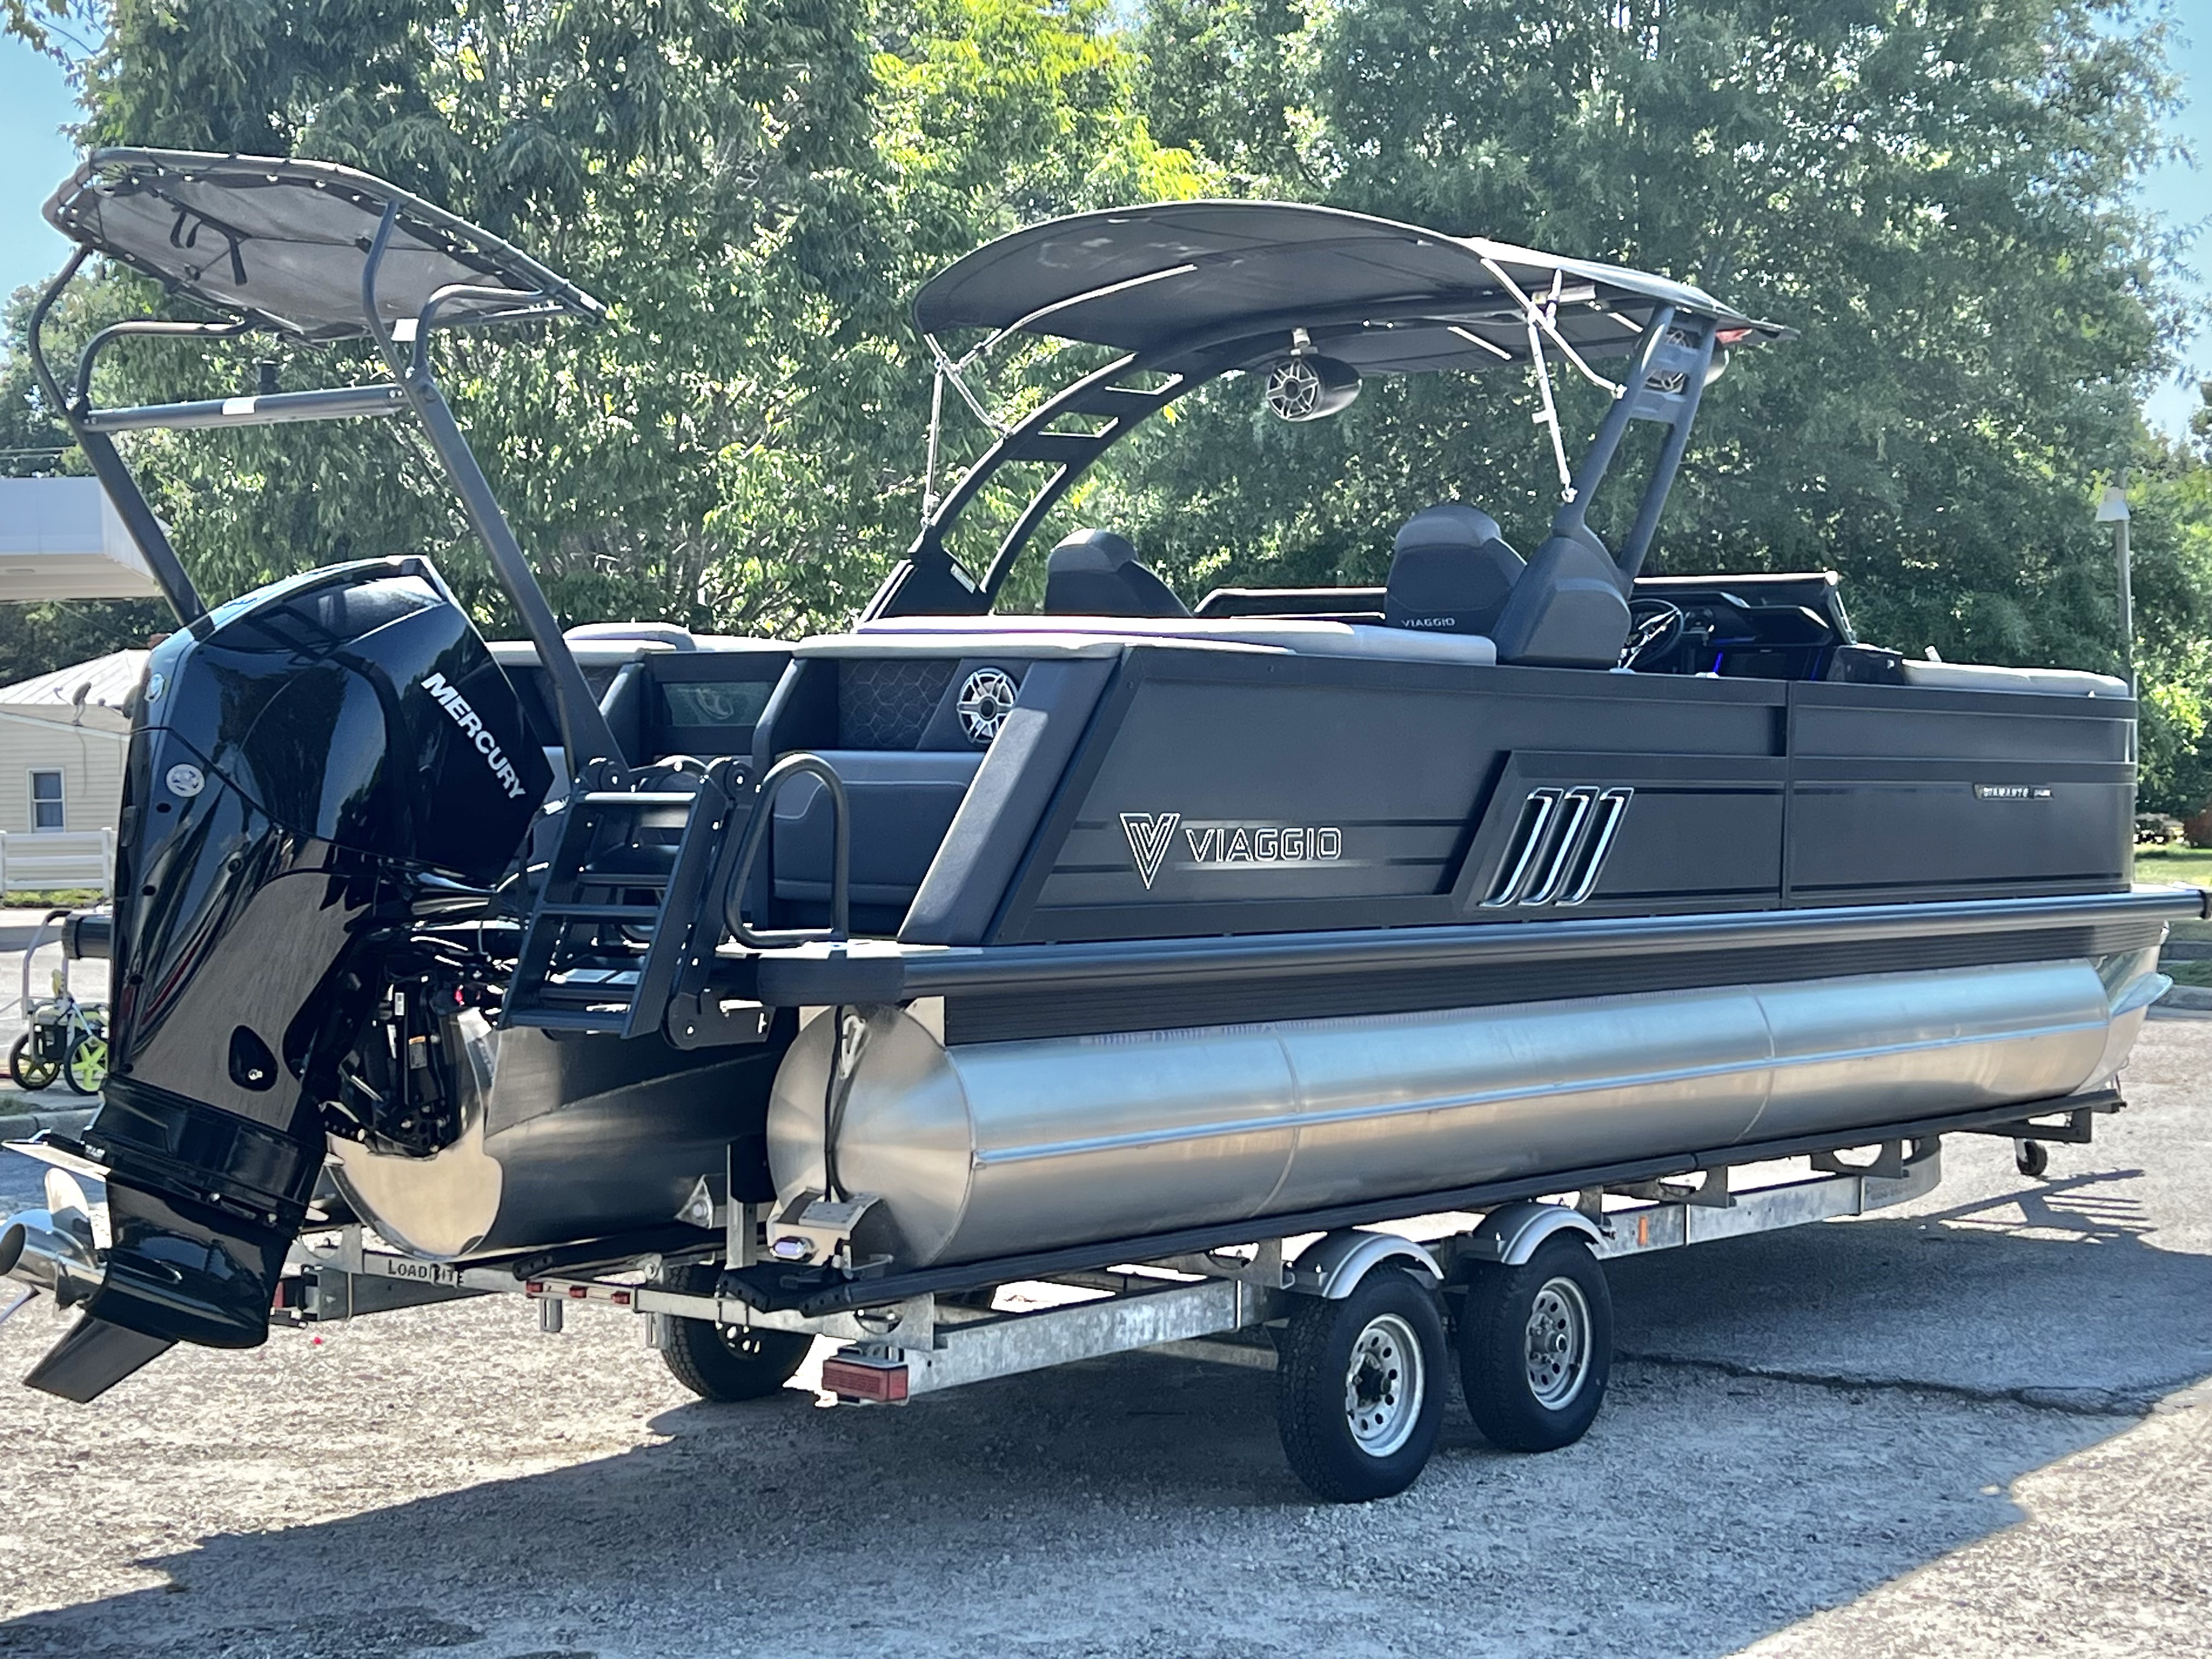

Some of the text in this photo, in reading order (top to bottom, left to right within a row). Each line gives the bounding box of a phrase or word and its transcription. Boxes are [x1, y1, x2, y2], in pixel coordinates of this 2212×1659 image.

[1401, 617, 1455, 628] VIAGGIO
[420, 672, 526, 799] MERCURY
[1186, 827, 1342, 863] VIAGGIO
